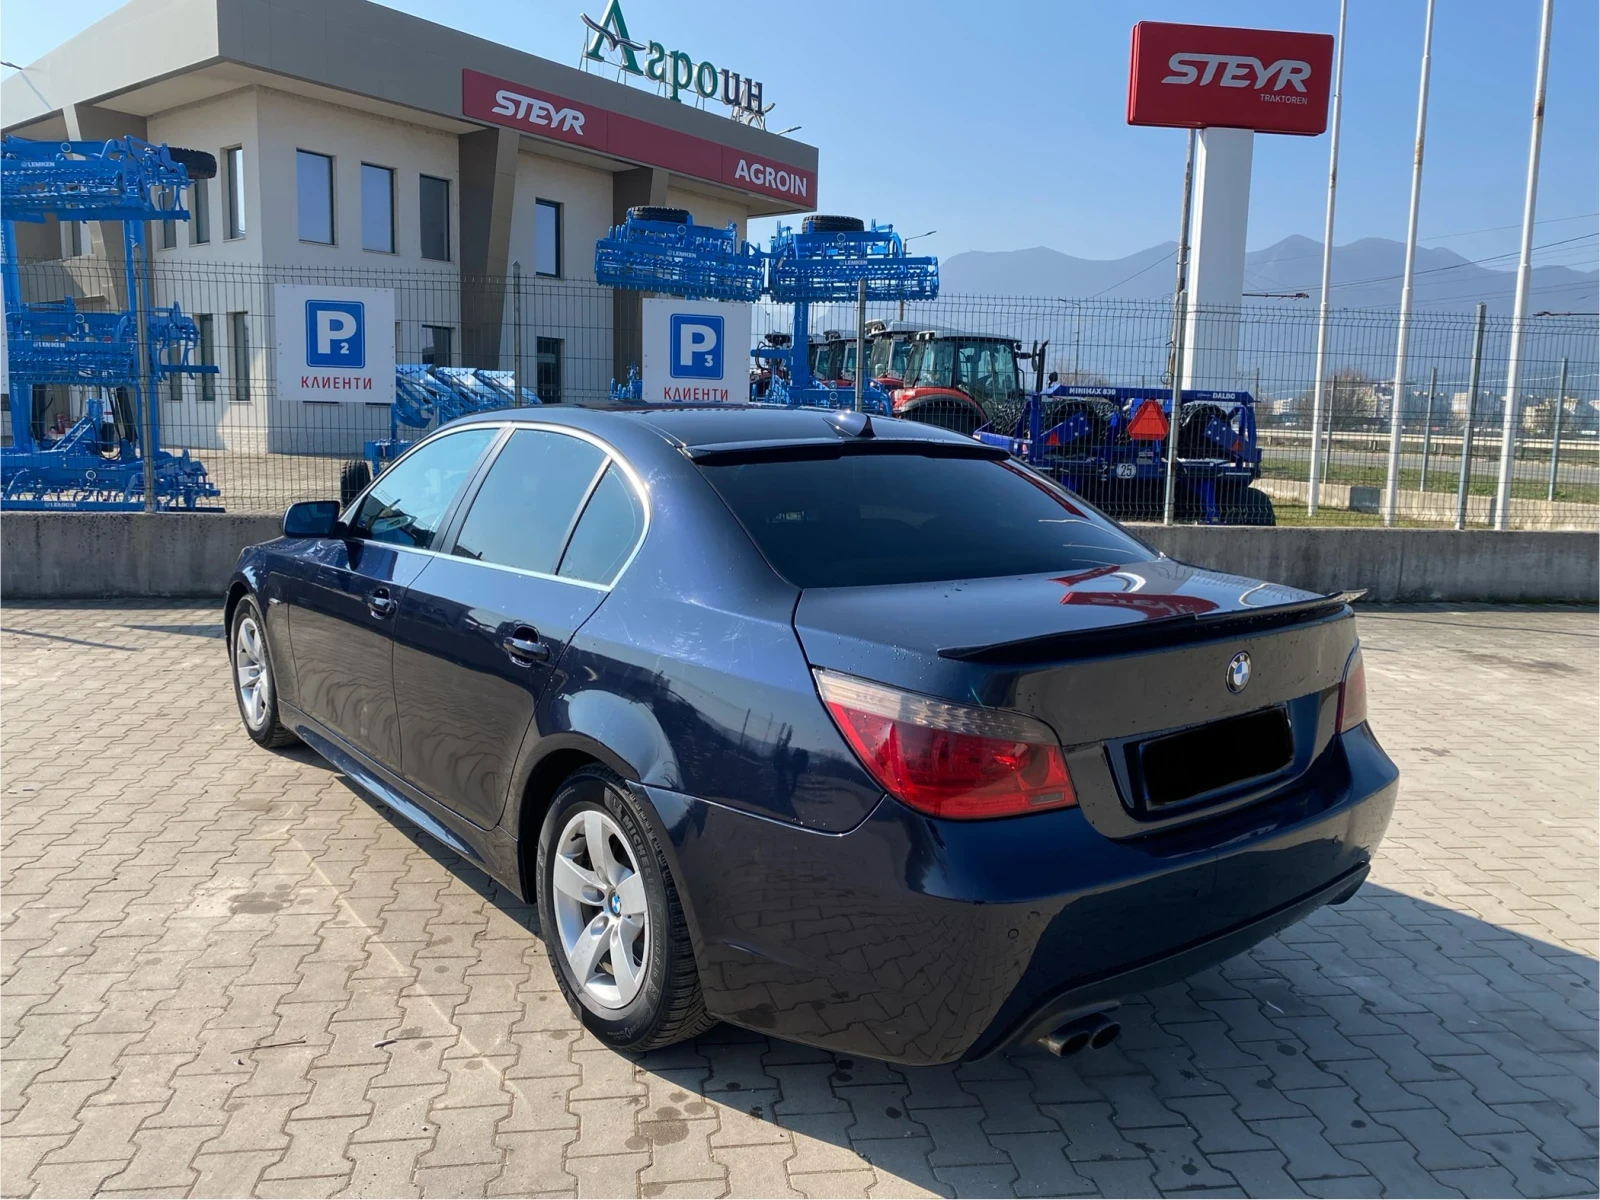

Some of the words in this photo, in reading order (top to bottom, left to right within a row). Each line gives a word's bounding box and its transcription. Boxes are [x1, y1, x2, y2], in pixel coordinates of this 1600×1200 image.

[1161, 52, 1312, 93] STEYR
[1260, 94, 1308, 105] TRAKTOREN
[491, 89, 585, 136] STEYR
[734, 159, 807, 197] AGROIN
[672, 250, 697, 258] LEMKEN
[301, 376, 372, 390] КЛИЕНТИ
[664, 387, 728, 402] КЛИЕНТИ
[1069, 387, 1102, 395] MINIMAX
[1103, 388, 1116, 396] 830
[1120, 465, 1133, 477] 25
